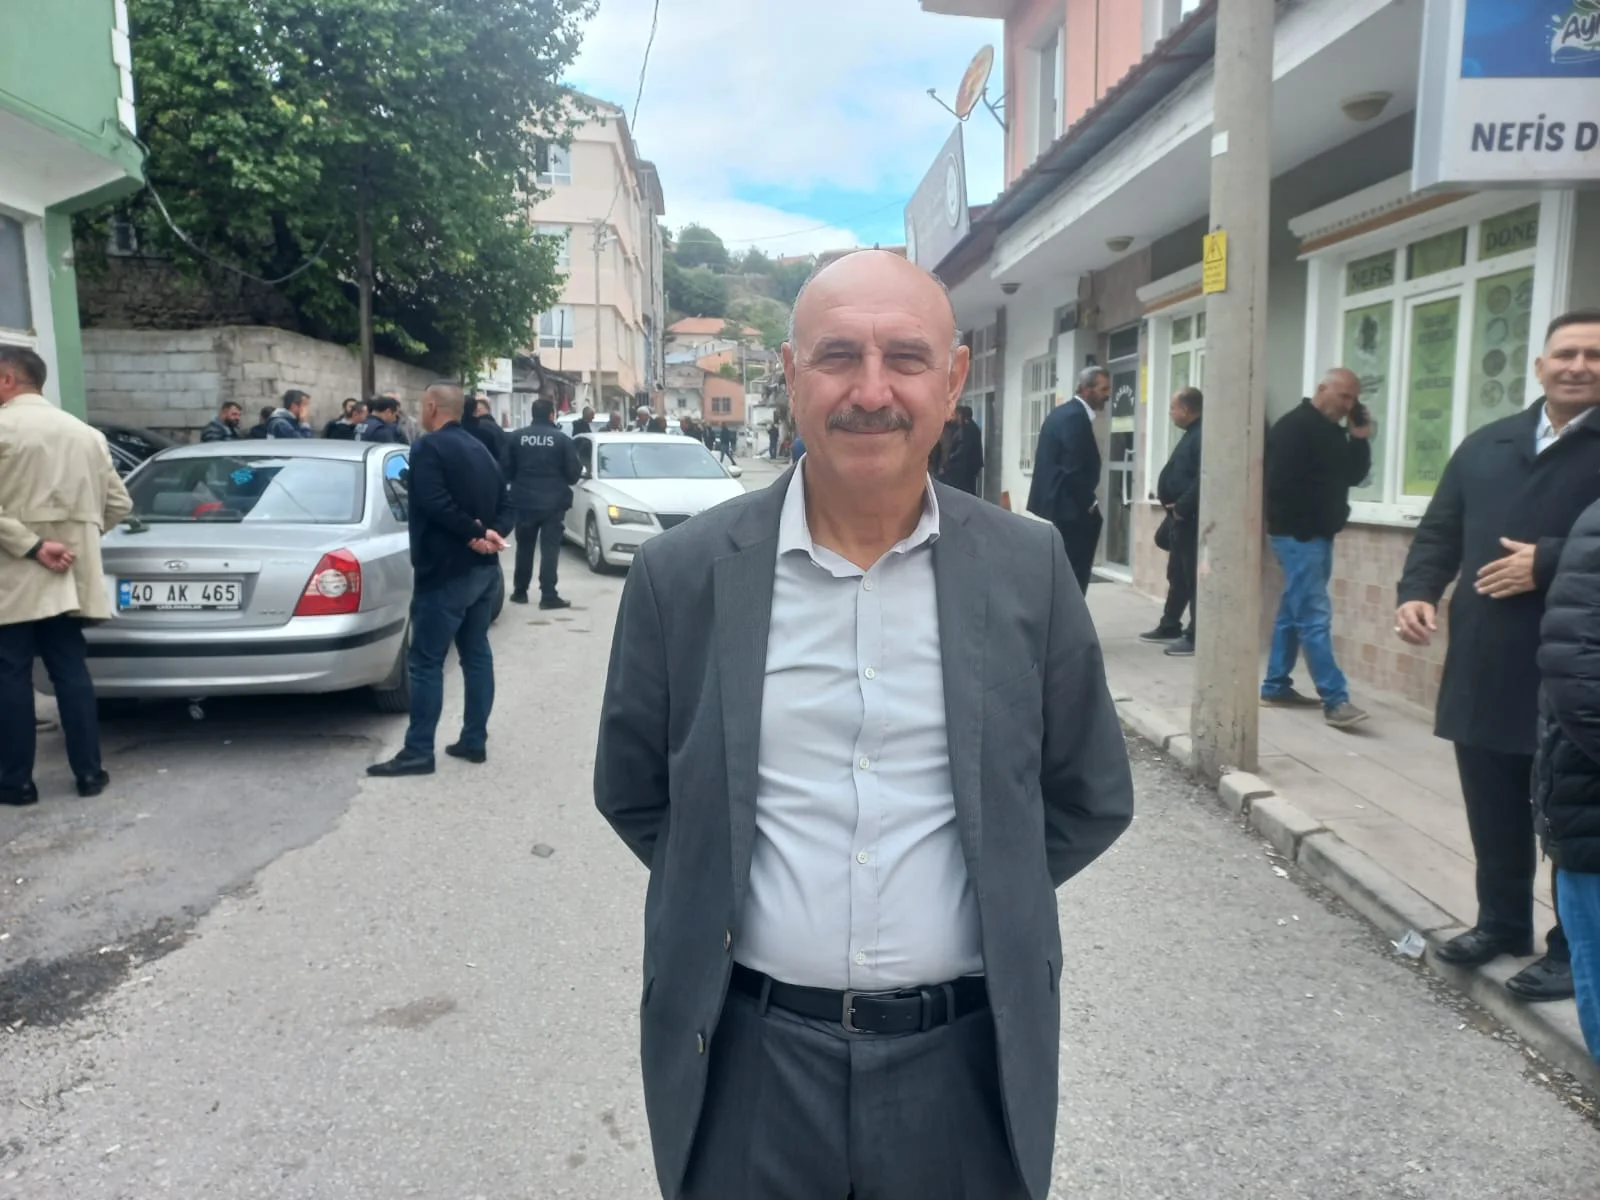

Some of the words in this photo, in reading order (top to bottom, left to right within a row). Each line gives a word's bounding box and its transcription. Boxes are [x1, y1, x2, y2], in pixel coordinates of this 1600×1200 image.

[1471, 113, 1566, 152] NEFİS
[131, 584, 153, 602] 40
[166, 584, 189, 602] AK
[201, 584, 236, 602] 465
